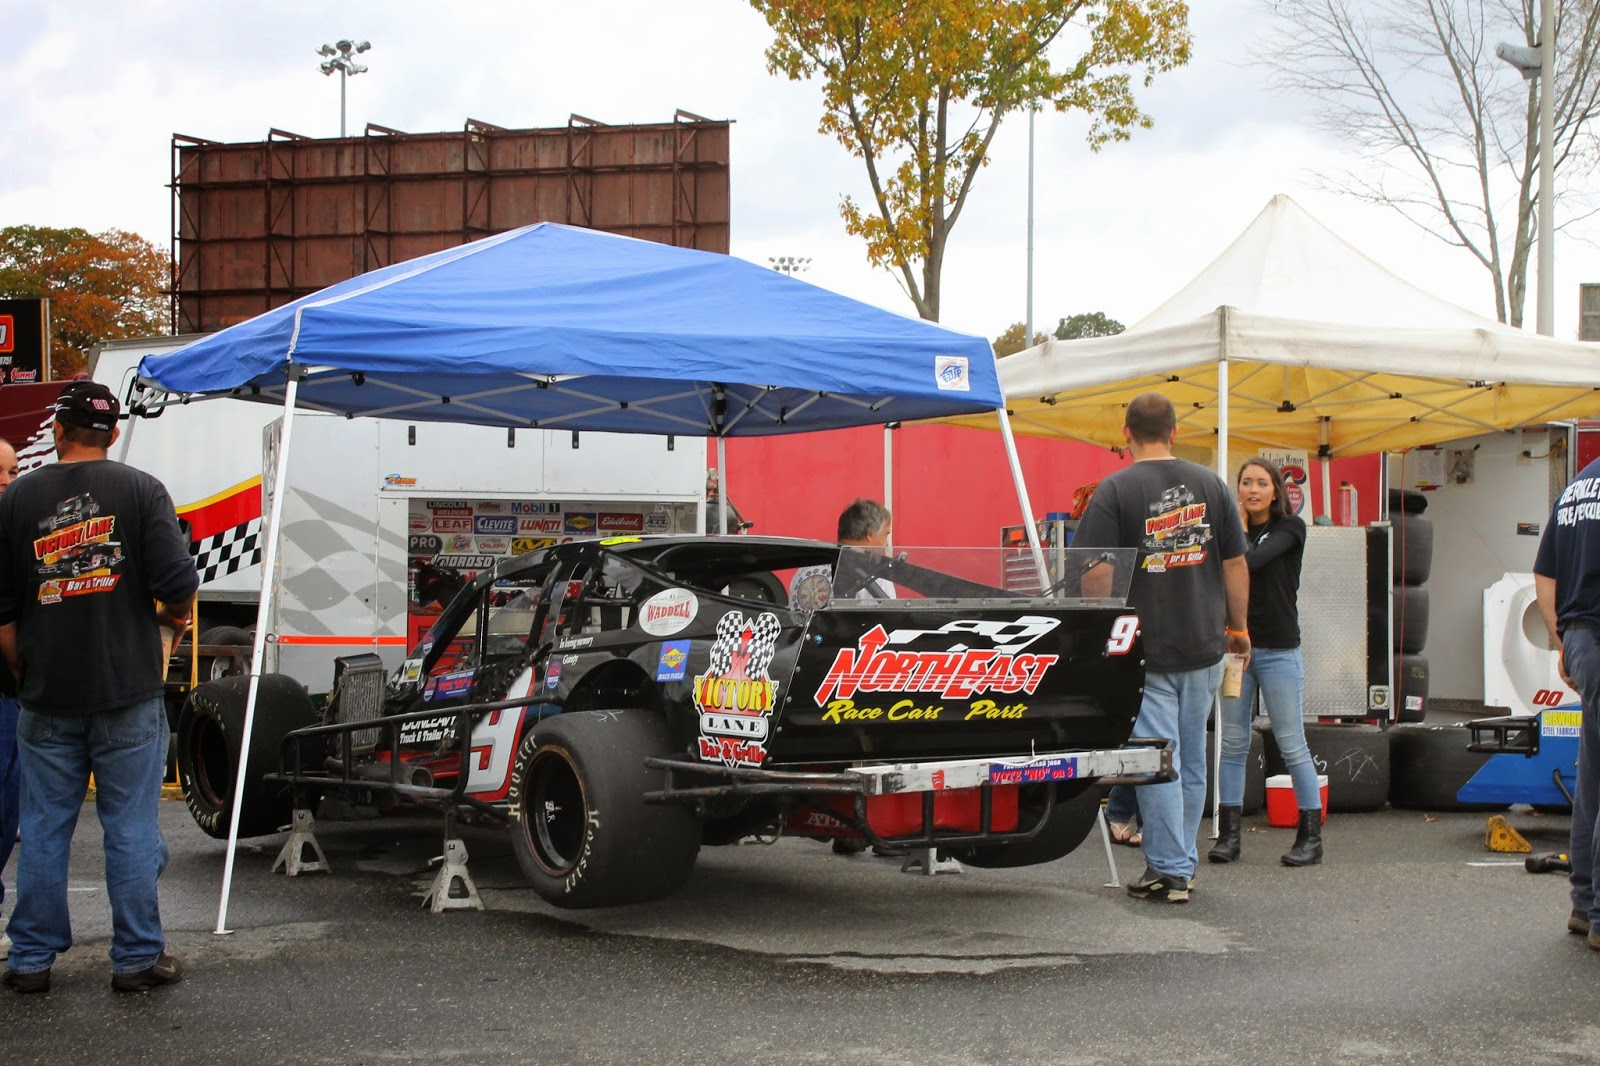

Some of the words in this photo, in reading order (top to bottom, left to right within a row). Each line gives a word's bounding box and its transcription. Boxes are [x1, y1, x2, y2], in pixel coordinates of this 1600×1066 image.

[512, 502, 546, 512] Mobil
[549, 503, 560, 513] 1
[435, 520, 470, 529] LEAF
[477, 517, 514, 531] CLEVITE
[520, 519, 562, 532] LUNATI
[565, 518, 595, 527] SUNOCO
[602, 516, 639, 527] Edelbrock
[35, 527, 84, 559] VICTORY
[86, 517, 115, 539] LANE
[410, 537, 437, 548] PRO
[67, 580, 84, 591] Bar
[648, 599, 691, 622] WADDELL
[1107, 615, 1140, 655] 9
[815, 630, 1059, 707] NORTHEAST
[694, 677, 778, 711] VICTORY
[1532, 689, 1564, 706] 00
[822, 700, 883, 724] Race
[887, 700, 944, 720] Cars
[964, 700, 1028, 720] Parts
[708, 717, 760, 732] LANE
[1556, 727, 1580, 736] FABRICAT
[400, 732, 416, 744] Truck
[422, 728, 443, 741] Trailer
[700, 739, 721, 759] Bar
[732, 741, 767, 763] Grille
[992, 770, 1022, 783] VOTE
[1052, 769, 1065, 779] on
[1066, 766, 1074, 778] 3
